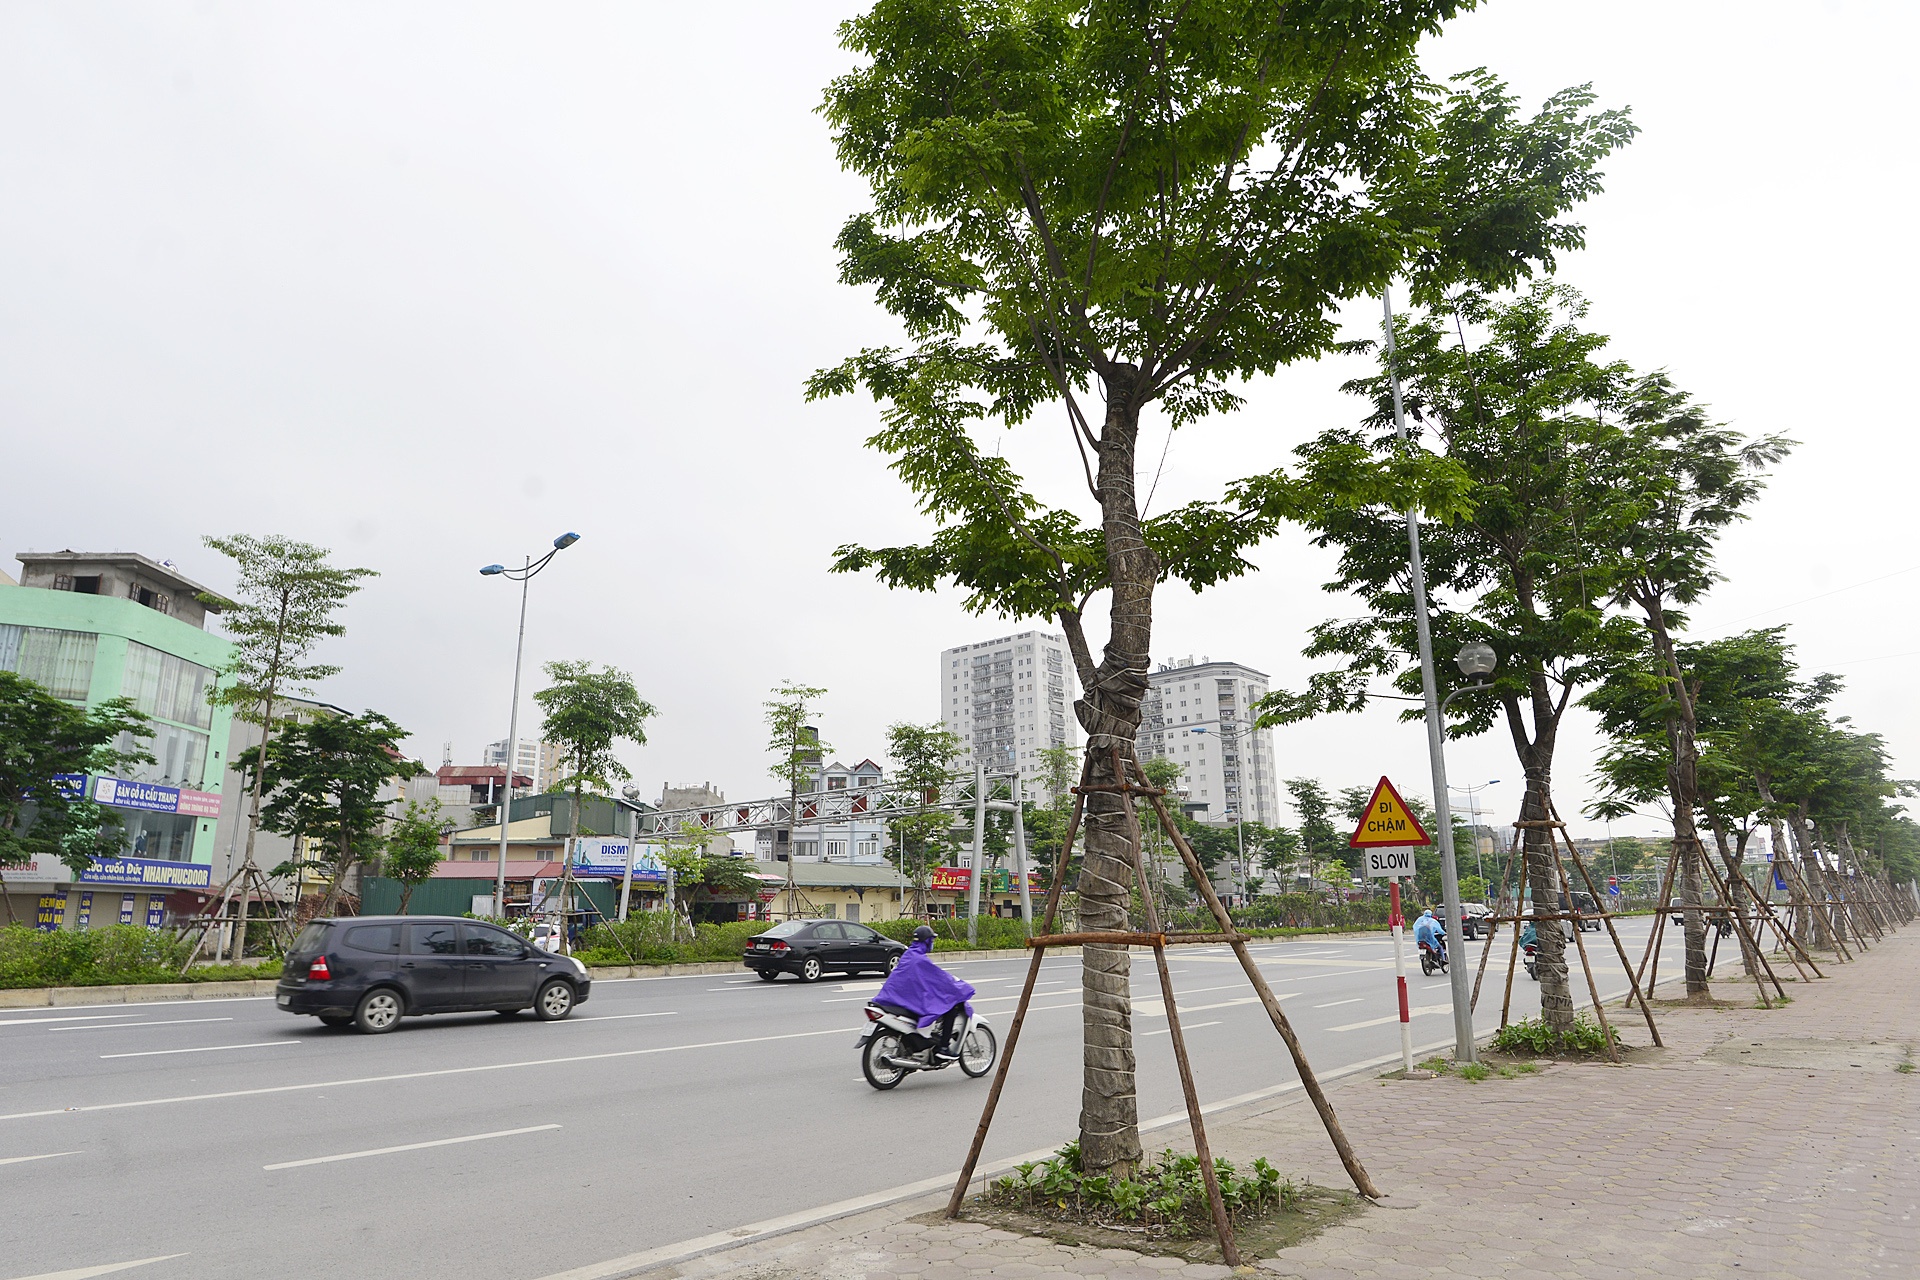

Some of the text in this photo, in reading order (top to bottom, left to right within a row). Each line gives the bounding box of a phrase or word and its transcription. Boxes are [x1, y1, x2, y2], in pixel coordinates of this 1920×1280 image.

[140, 789, 144, 799] &
[158, 792, 177, 804] THANG
[1379, 802, 1392, 813] ĐI
[1368, 818, 1406, 834] CHẬM
[1371, 853, 1408, 869] SLOW
[143, 865, 208, 885] NHANPHUCDOOR
